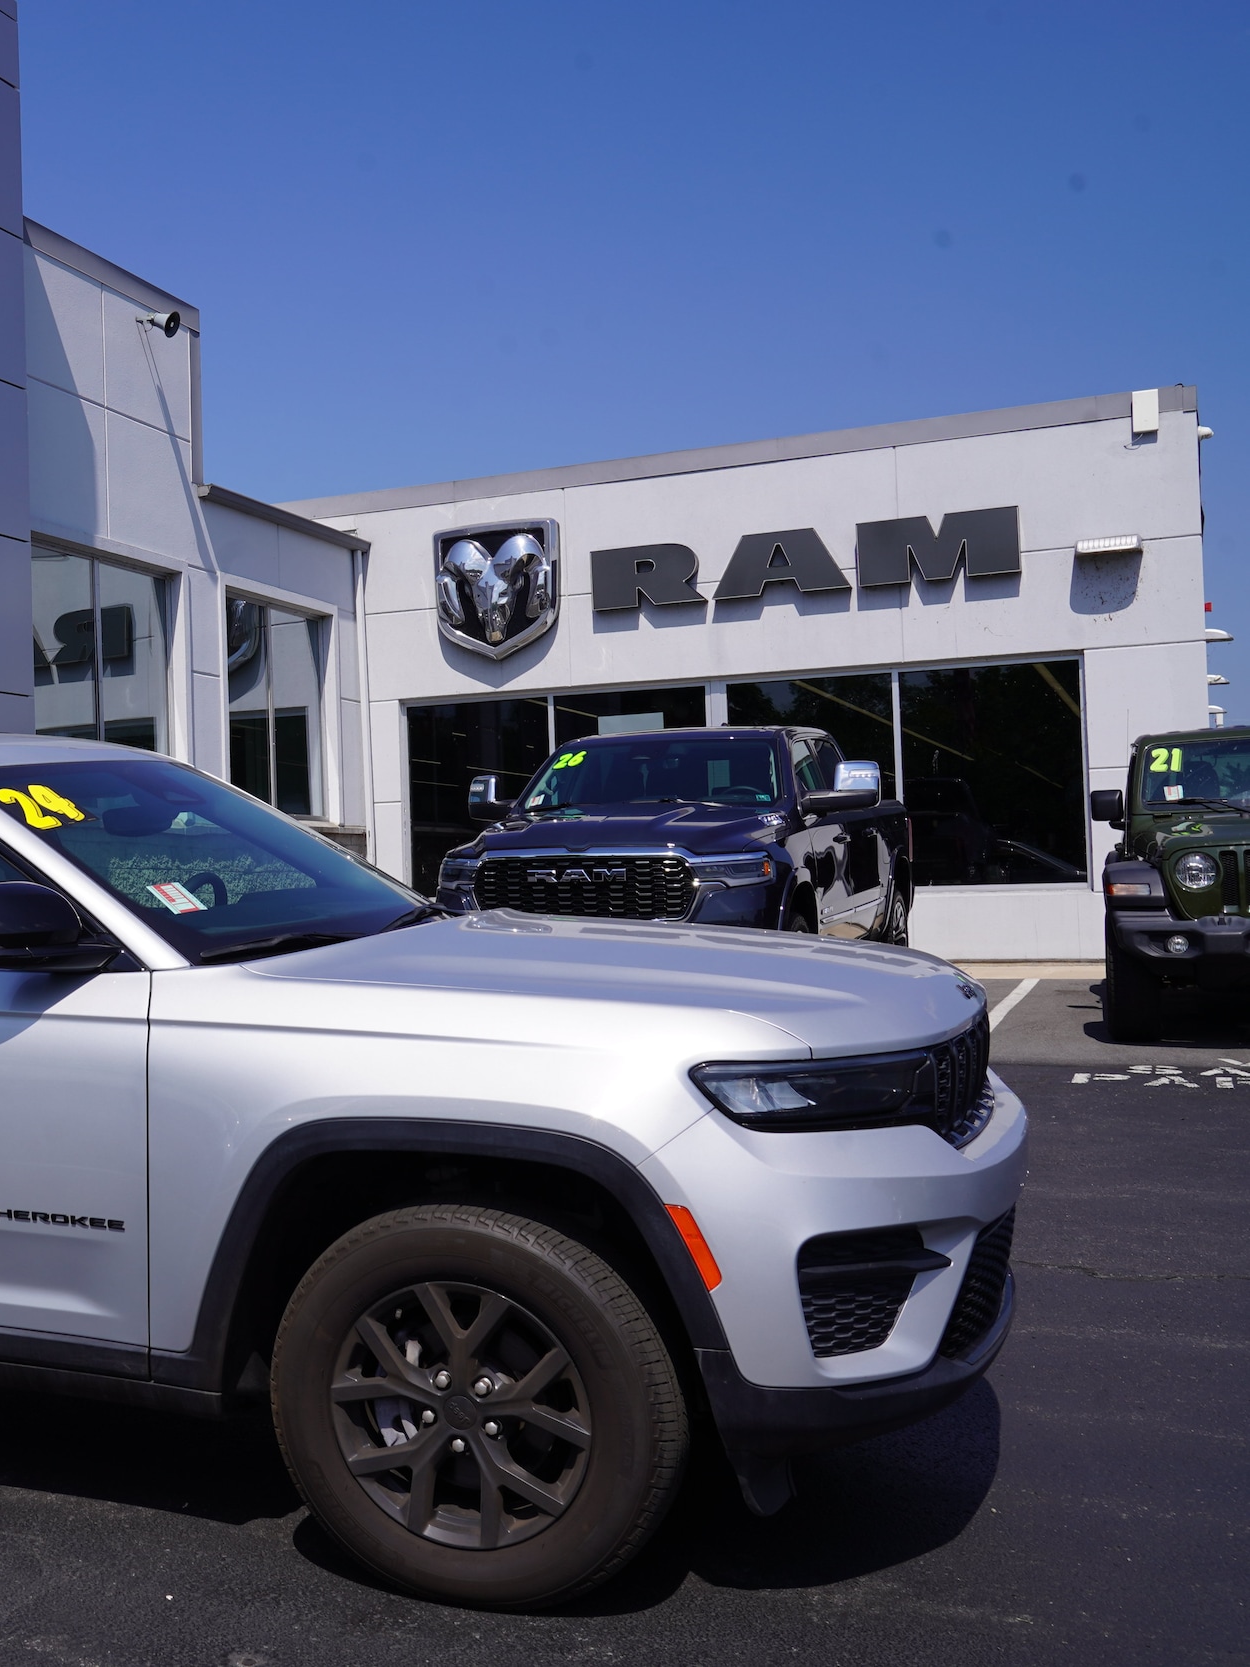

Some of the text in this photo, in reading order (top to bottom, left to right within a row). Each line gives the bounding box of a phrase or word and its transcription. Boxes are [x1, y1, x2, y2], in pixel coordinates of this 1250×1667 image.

[590, 505, 1022, 612] RAM
[552, 750, 588, 770] 26
[1149, 748, 1182, 773] 21
[527, 868, 627, 883] RAM
